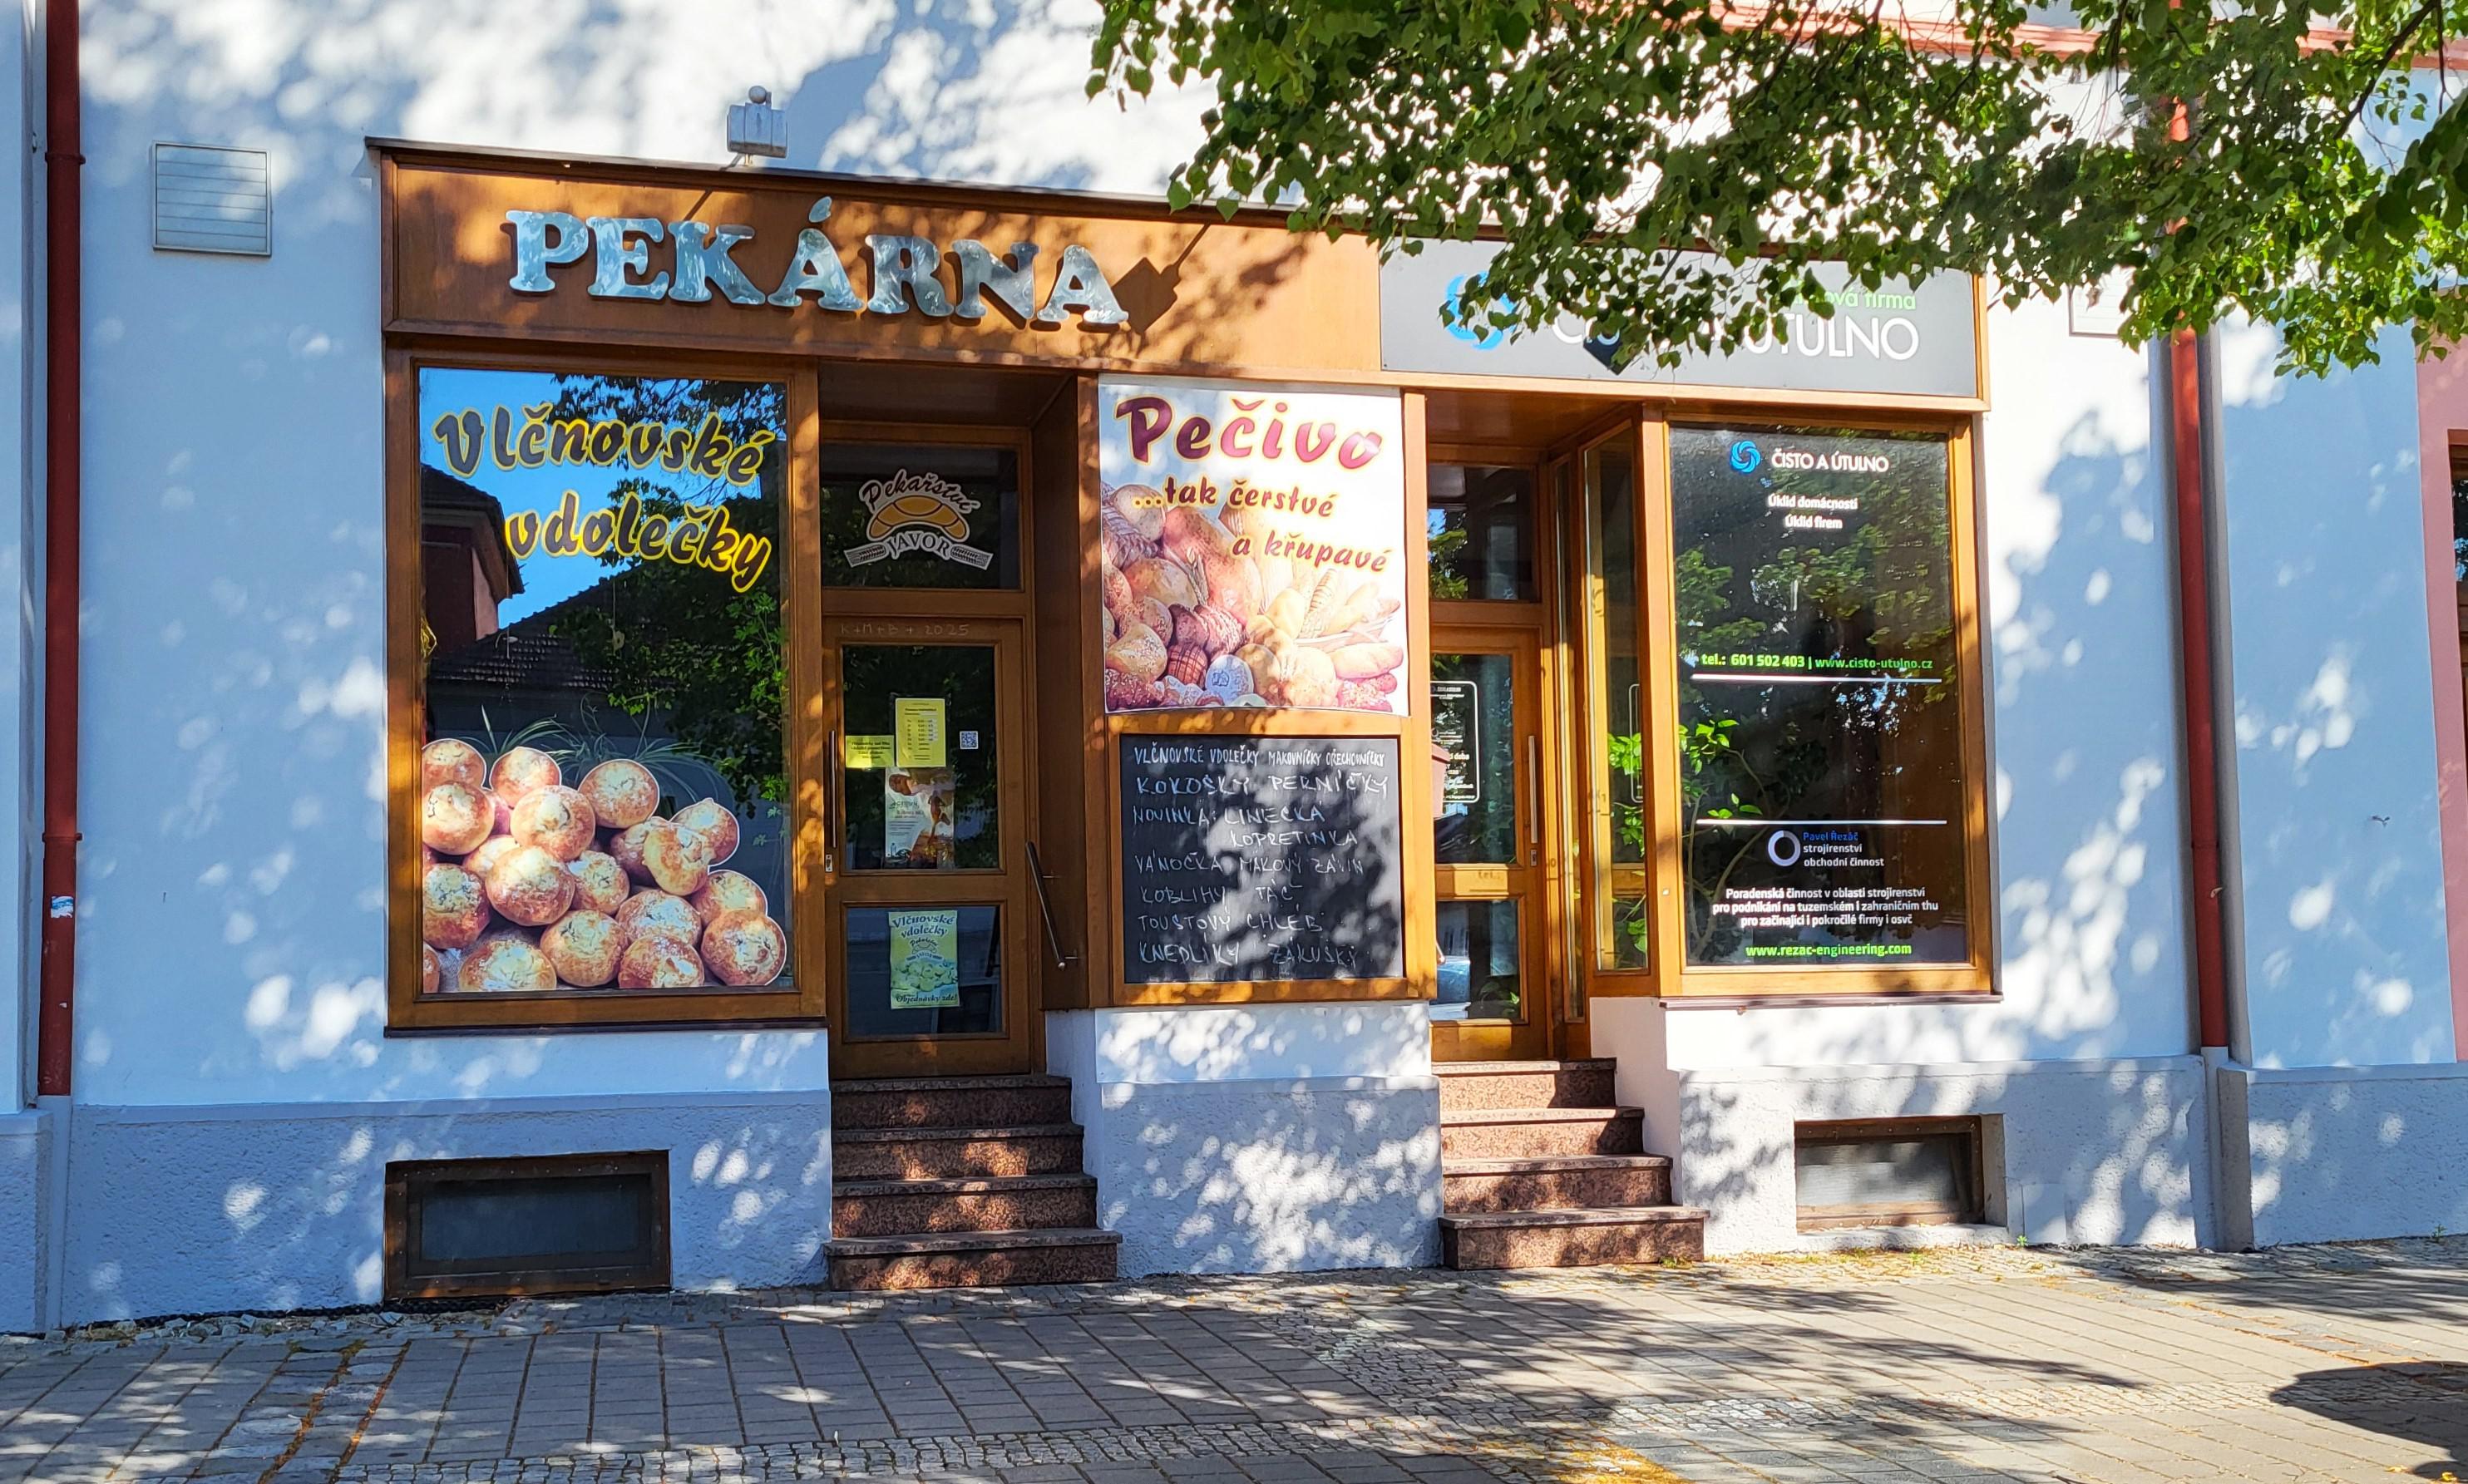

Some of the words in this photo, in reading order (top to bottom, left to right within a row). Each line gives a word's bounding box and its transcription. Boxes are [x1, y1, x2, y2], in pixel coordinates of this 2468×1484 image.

[506, 196, 1128, 328] PEKÁRNA
[1864, 290, 1916, 310] firma
[1115, 395, 1384, 471] Pečivo
[432, 402, 776, 487] Vlčnovské
[1771, 448, 1814, 470] ČISTO
[1816, 454, 1829, 471] A
[1831, 451, 1889, 472] ÚTULNO
[861, 470, 978, 511] Pekařství
[1229, 480, 1338, 518] čerstvé
[1768, 493, 1796, 508] Úklid
[1784, 514, 1813, 528] Úklid
[1814, 515, 1844, 530] firem
[505, 489, 772, 593] vdolečky
[886, 532, 950, 557] JAVOR
[1232, 535, 1251, 557] a
[1265, 530, 1394, 572] křupavé
[1730, 653, 1754, 666] 601
[1756, 655, 1779, 667] 502
[1781, 655, 1805, 668] 403
[1814, 657, 1933, 670] www.cisto-utulno.cz
[1134, 741, 1204, 765] VLČNOVSKÉ
[1210, 744, 1259, 767] VDOLEČKY
[1268, 748, 1321, 767] MAKOVNÍČKY
[1230, 829, 1358, 847] KOPRETINKA
[1803, 831, 1829, 841] Pavel
[1803, 844, 1863, 855] strojírenství
[1804, 857, 1848, 867] obchodní
[1849, 856, 1885, 867] činnost
[1140, 885, 1226, 905] KOBLIHY
[1725, 887, 1784, 899] Poradenská
[1786, 887, 1823, 899] činnost
[1824, 890, 1830, 898] v
[1832, 887, 1866, 898] oblasti
[1868, 886, 1926, 900] strojírenství
[1712, 903, 1730, 915] pro
[1731, 900, 1781, 915] podnikání
[1782, 904, 1796, 913] na
[1798, 901, 1854, 912] tuzemském
[1862, 900, 1920, 911] zahraničním
[891, 914, 955, 929] Vlčnovské
[1740, 916, 1759, 929] pro
[1760, 915, 1804, 929] začínající
[1811, 914, 1857, 928] pokročilé
[1858, 914, 1884, 927] firmy
[1891, 913, 1913, 924] osvč
[901, 924, 948, 939] vdolečky
[1745, 944, 1913, 958] www.rezac-engineering.com
